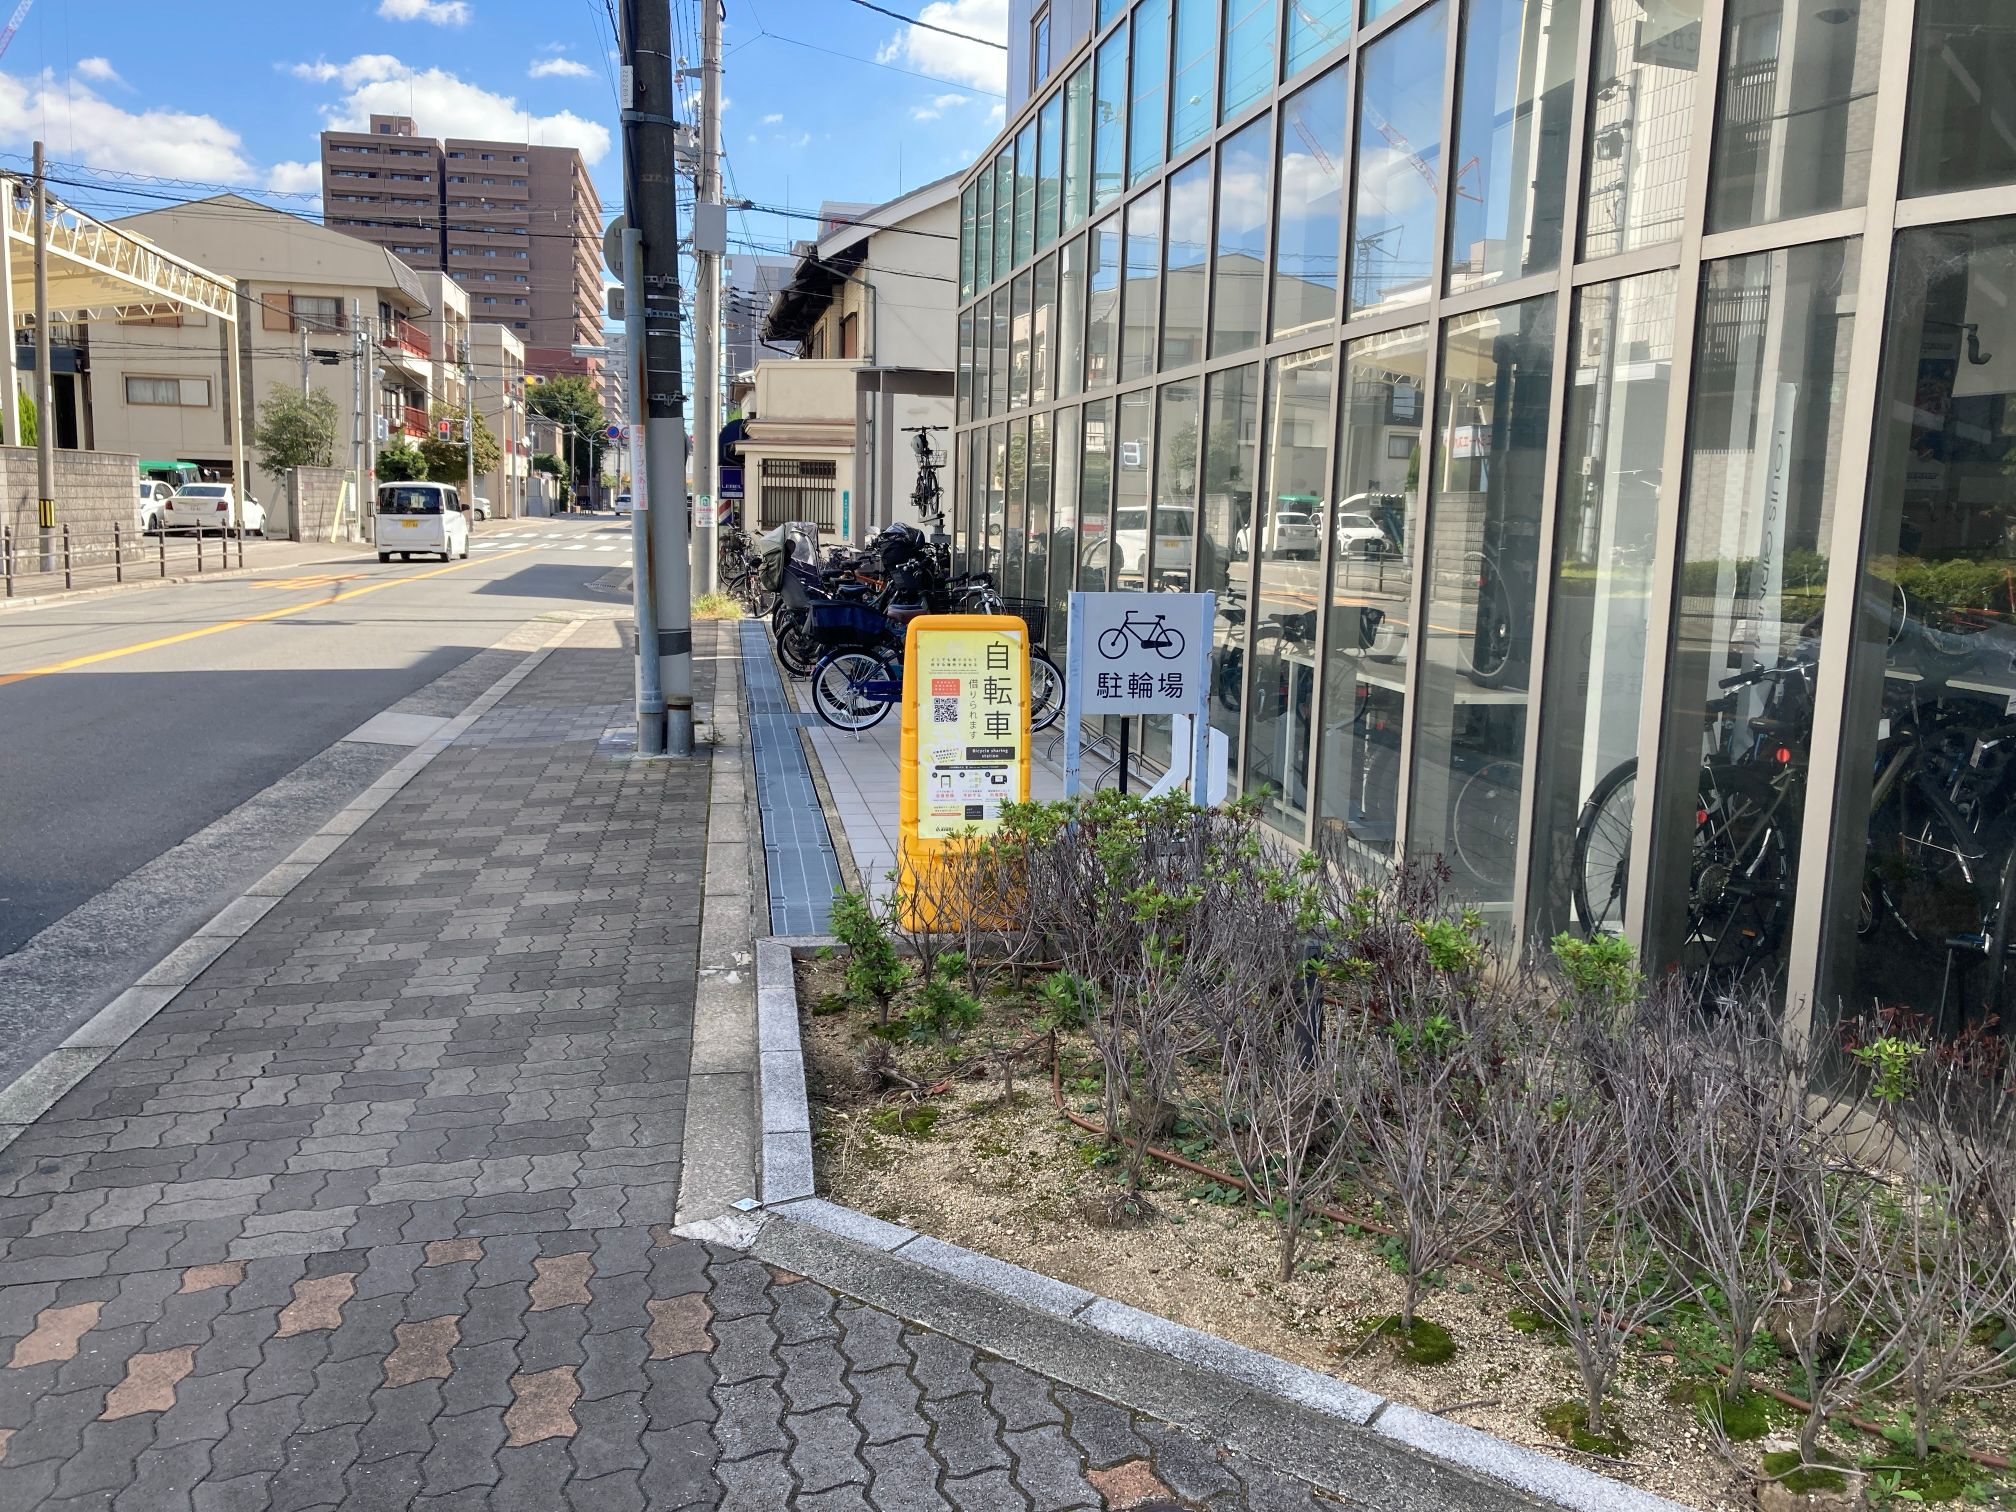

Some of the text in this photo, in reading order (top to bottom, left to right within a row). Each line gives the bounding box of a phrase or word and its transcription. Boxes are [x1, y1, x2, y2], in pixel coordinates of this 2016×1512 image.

[968, 679, 979, 739] 借りられます
[984, 641, 1012, 740] 自転車
[1096, 672, 1184, 699] 駐輪場
